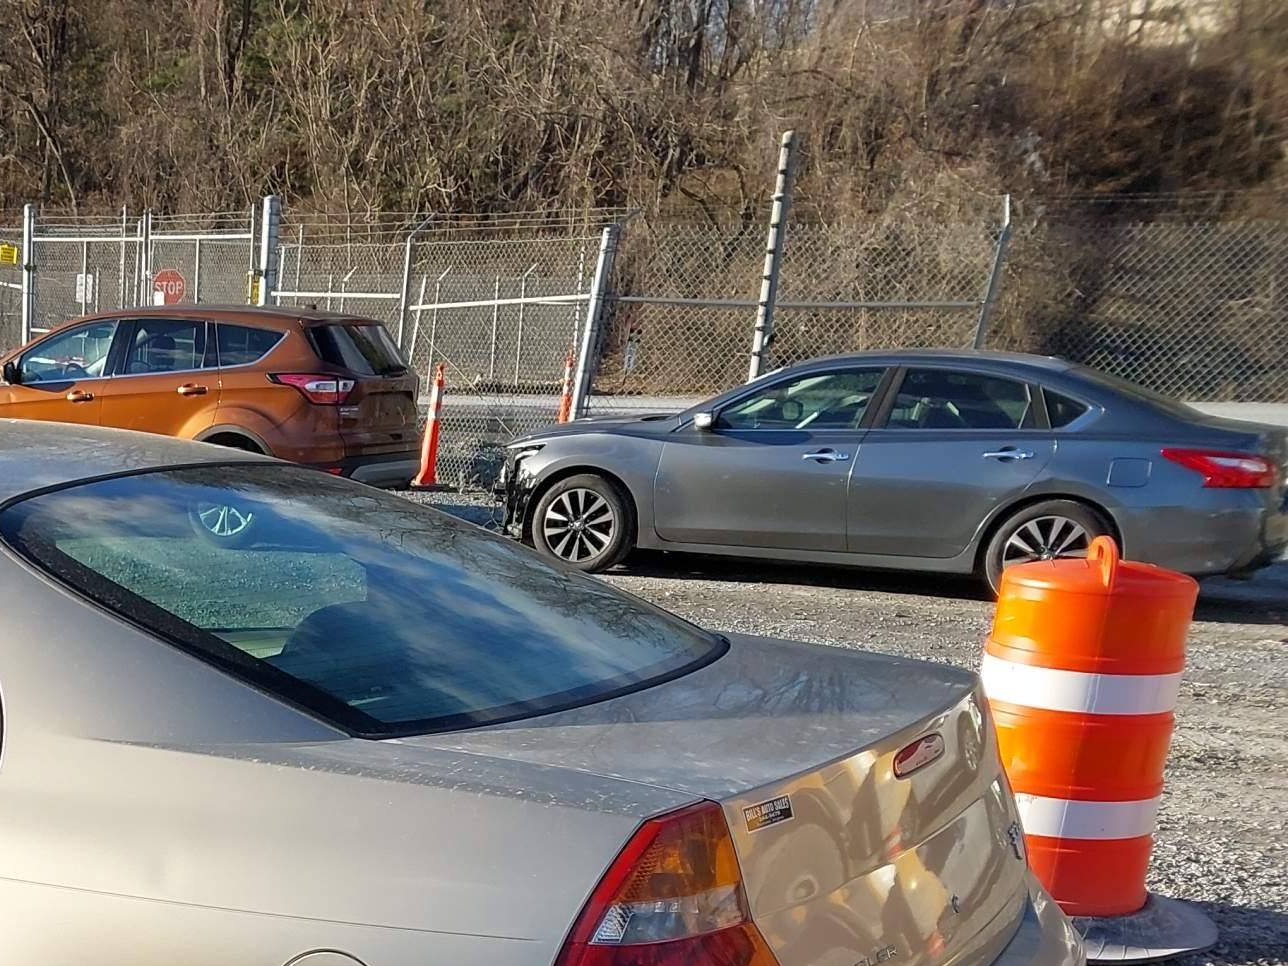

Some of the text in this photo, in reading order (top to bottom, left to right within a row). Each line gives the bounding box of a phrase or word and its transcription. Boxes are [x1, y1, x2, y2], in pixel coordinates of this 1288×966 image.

[155, 281, 183, 295] STOP
[761, 801, 775, 815] AUTO
[773, 797, 790, 811] SALES
